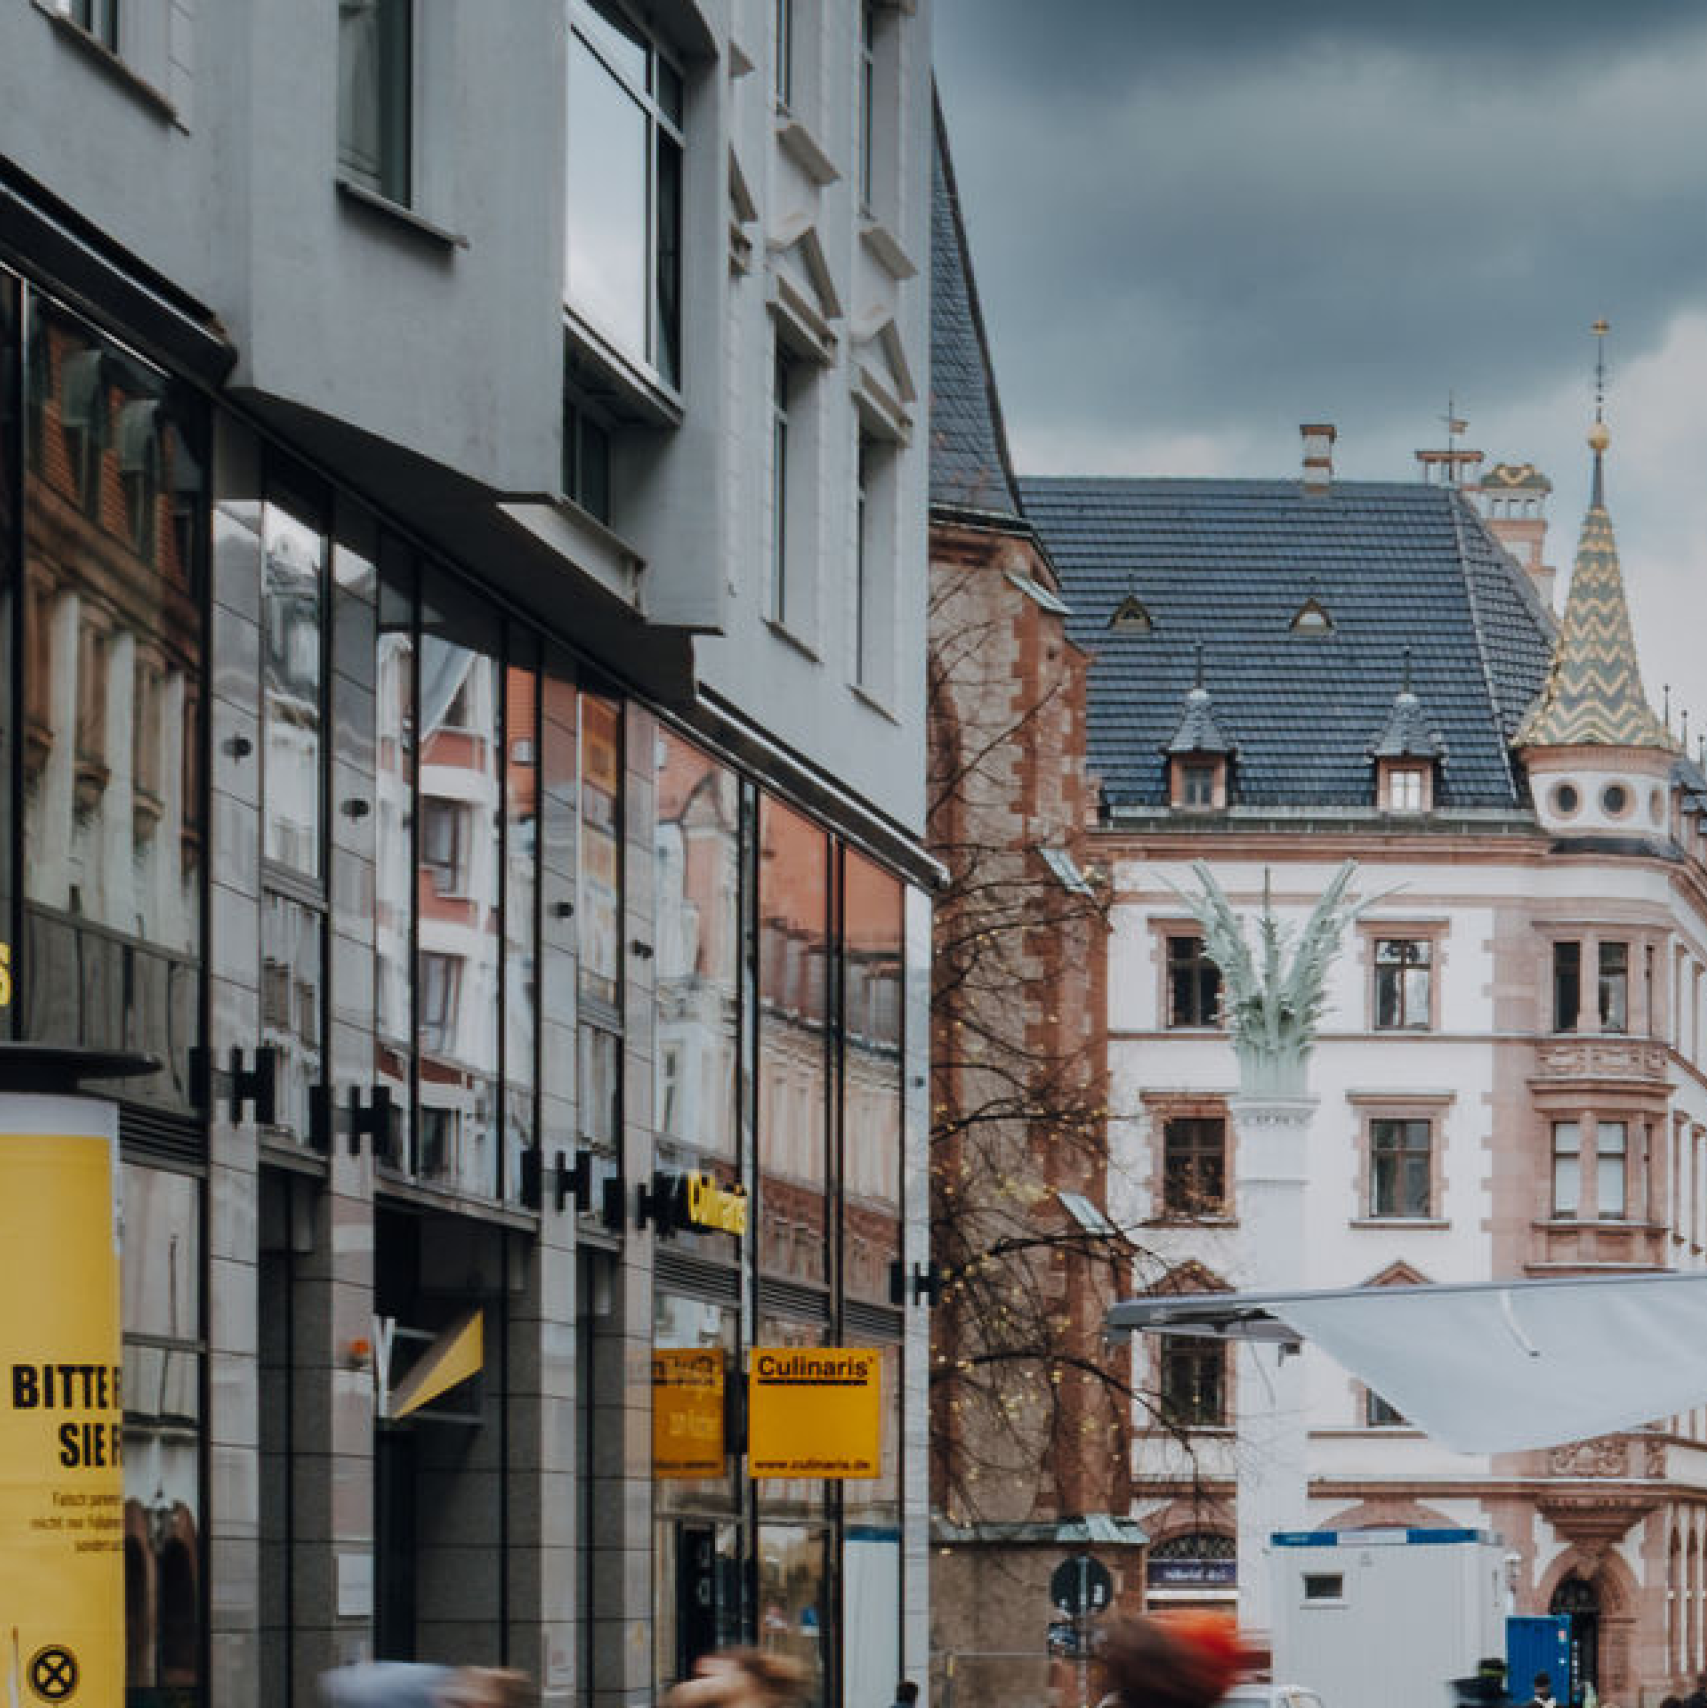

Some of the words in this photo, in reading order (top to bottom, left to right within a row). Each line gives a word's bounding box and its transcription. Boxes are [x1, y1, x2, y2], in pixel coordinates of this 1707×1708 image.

[12, 1364, 108, 1409] BITTE
[758, 1355, 873, 1379] Culinaris
[59, 1423, 107, 1469] SIE
